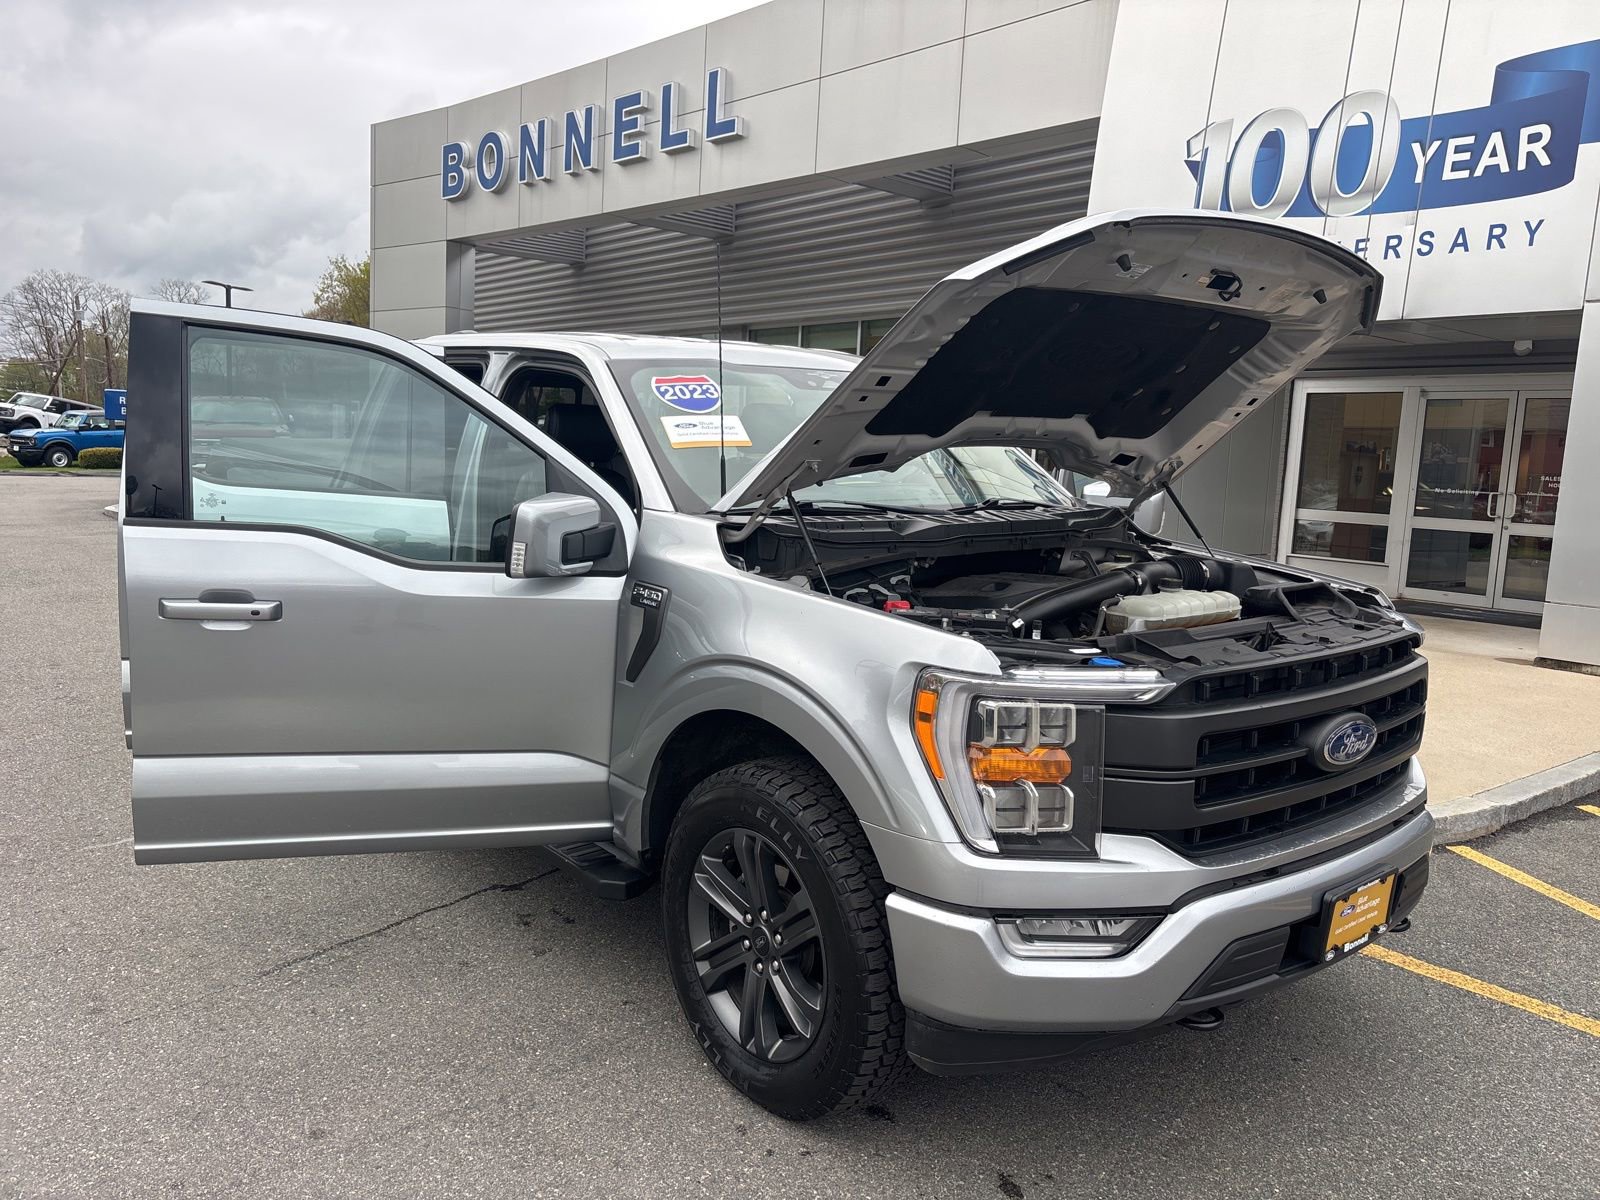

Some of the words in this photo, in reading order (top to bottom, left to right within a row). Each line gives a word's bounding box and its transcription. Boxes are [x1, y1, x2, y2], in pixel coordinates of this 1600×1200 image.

[441, 67, 744, 200] BONNELL
[1186, 89, 1401, 219] 100
[1410, 123, 1552, 184] YEAR
[1338, 218, 1545, 260] ERSARY
[660, 384, 719, 400] 2023
[1334, 728, 1370, 759] Ford
[1344, 932, 1368, 952] Bonnell
